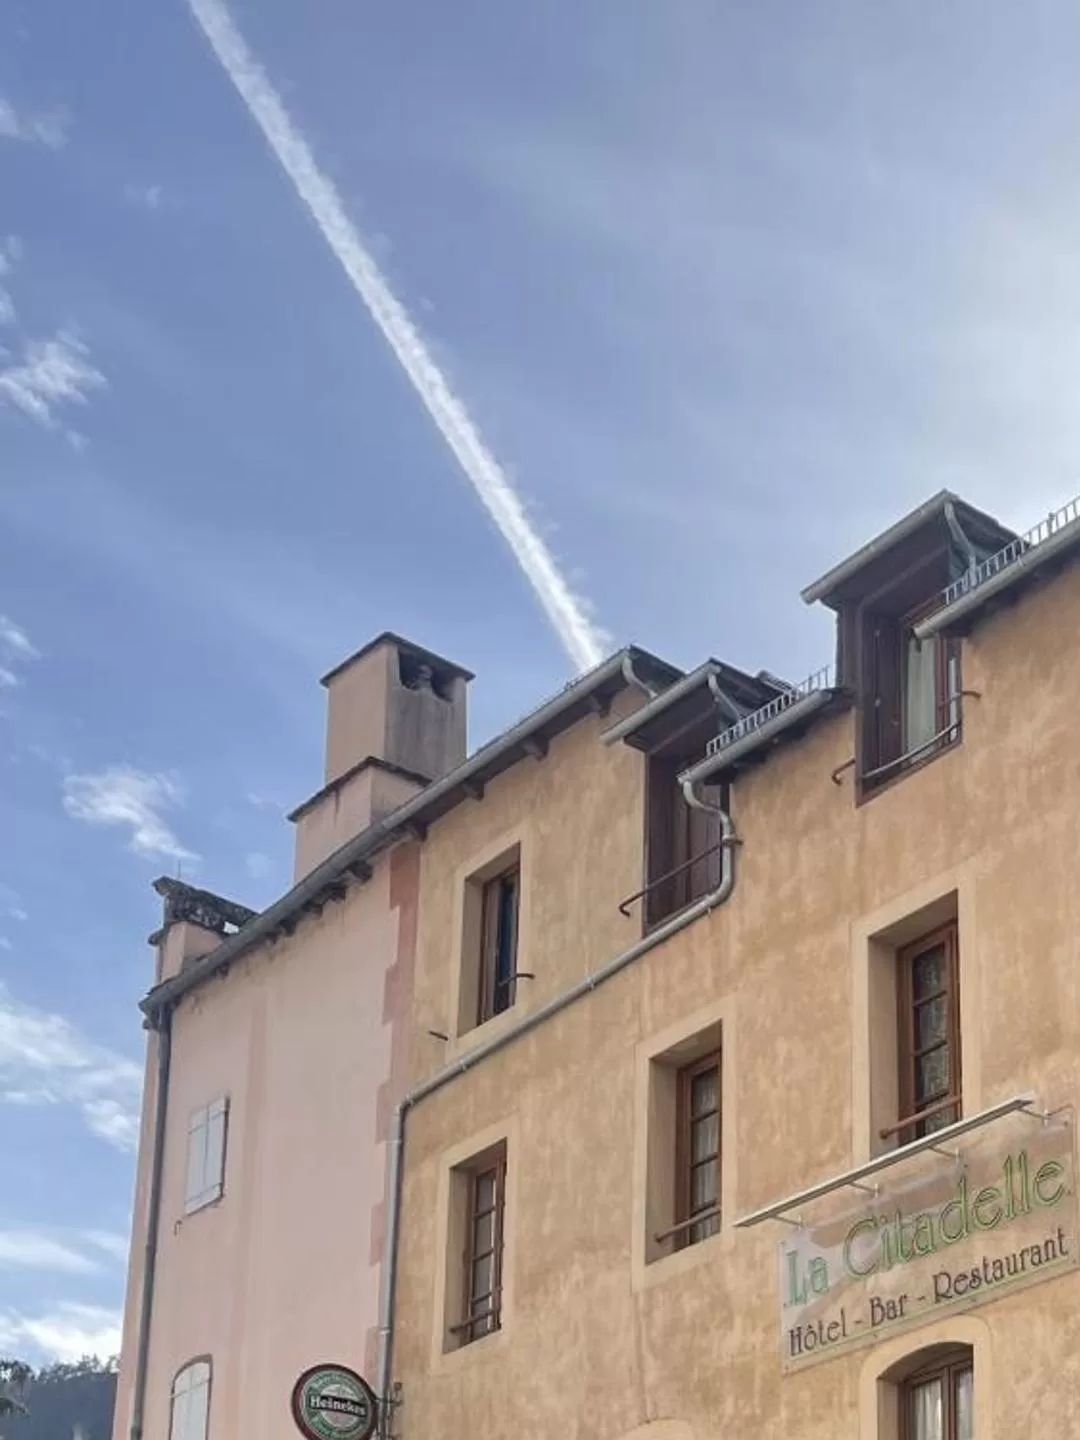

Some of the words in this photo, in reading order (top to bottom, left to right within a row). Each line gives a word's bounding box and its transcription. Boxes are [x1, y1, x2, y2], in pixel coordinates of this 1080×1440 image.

[786, 1249, 829, 1307] La
[842, 1150, 1066, 1282] Citadelle
[788, 1307, 847, 1357] Hôtel
[870, 1294, 908, 1327] Bar
[932, 1228, 1069, 1304] Restaurant
